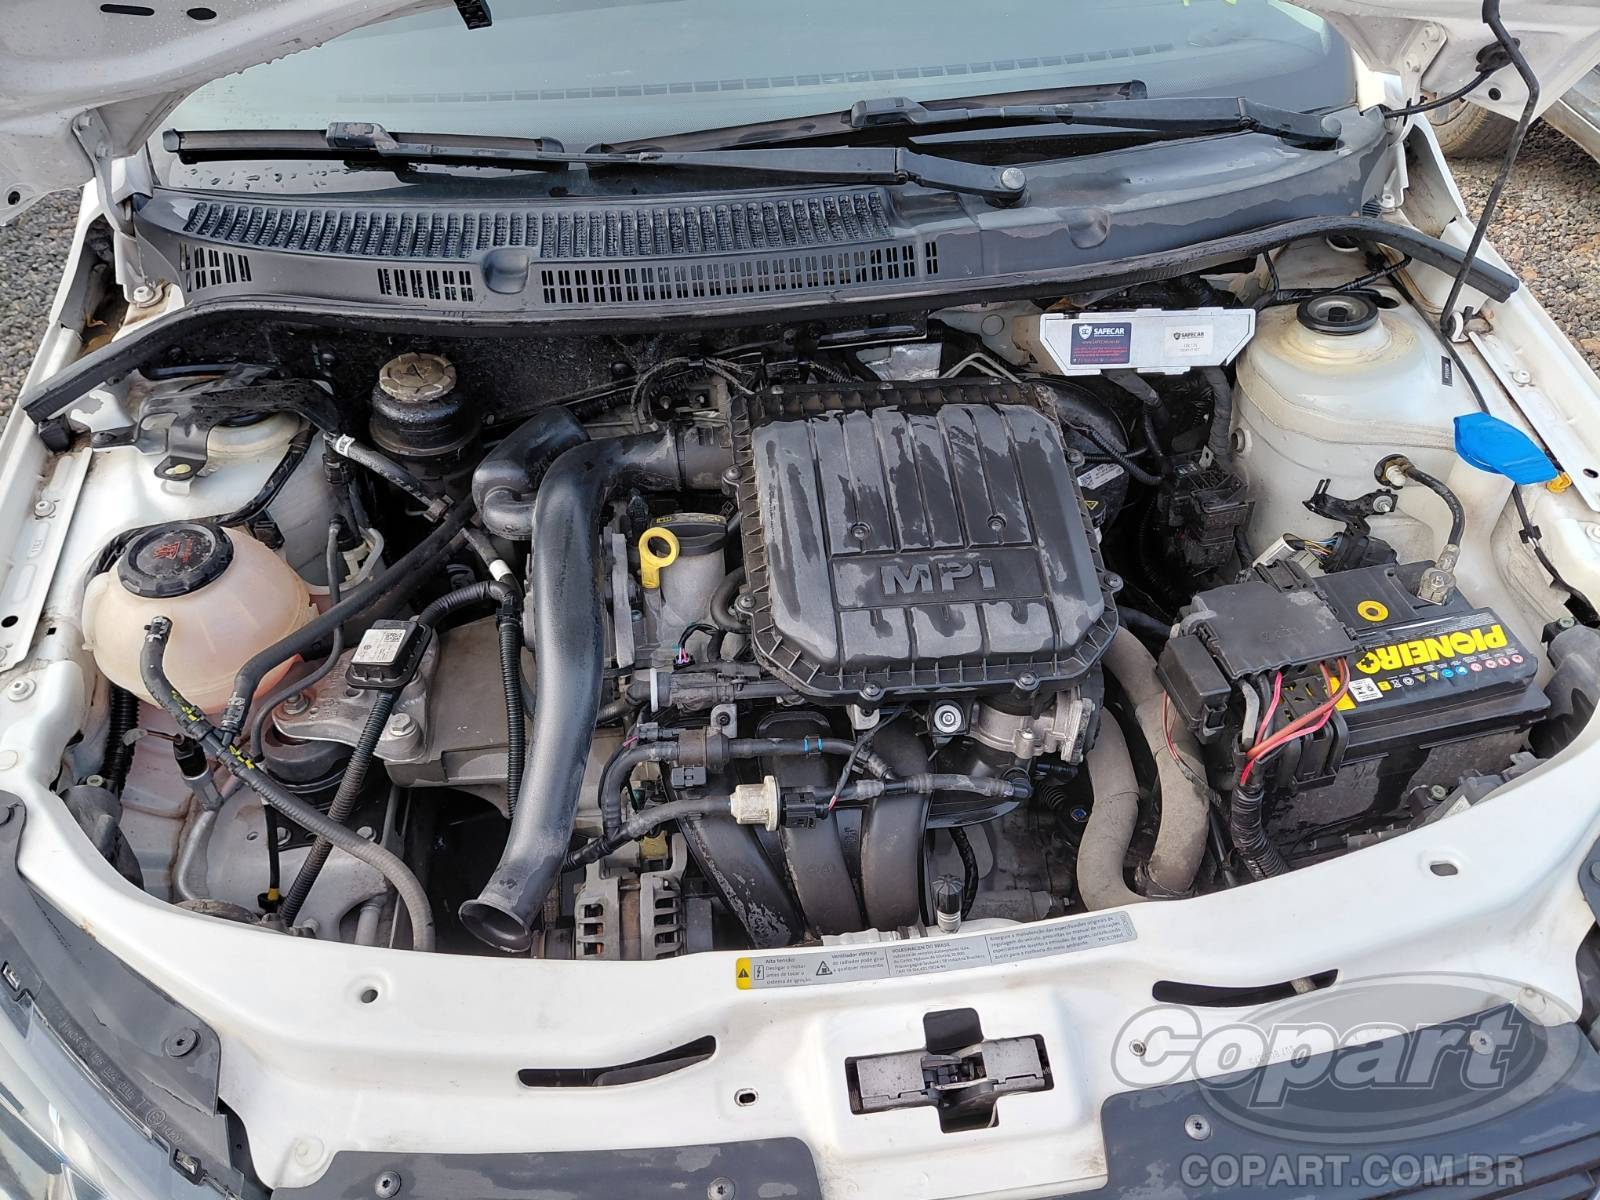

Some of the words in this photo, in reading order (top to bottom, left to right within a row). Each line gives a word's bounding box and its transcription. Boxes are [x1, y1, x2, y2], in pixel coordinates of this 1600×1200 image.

[1094, 327, 1125, 335] SAFECAR
[881, 560, 996, 595] MPI
[1356, 625, 1507, 674] PIONEIRO
